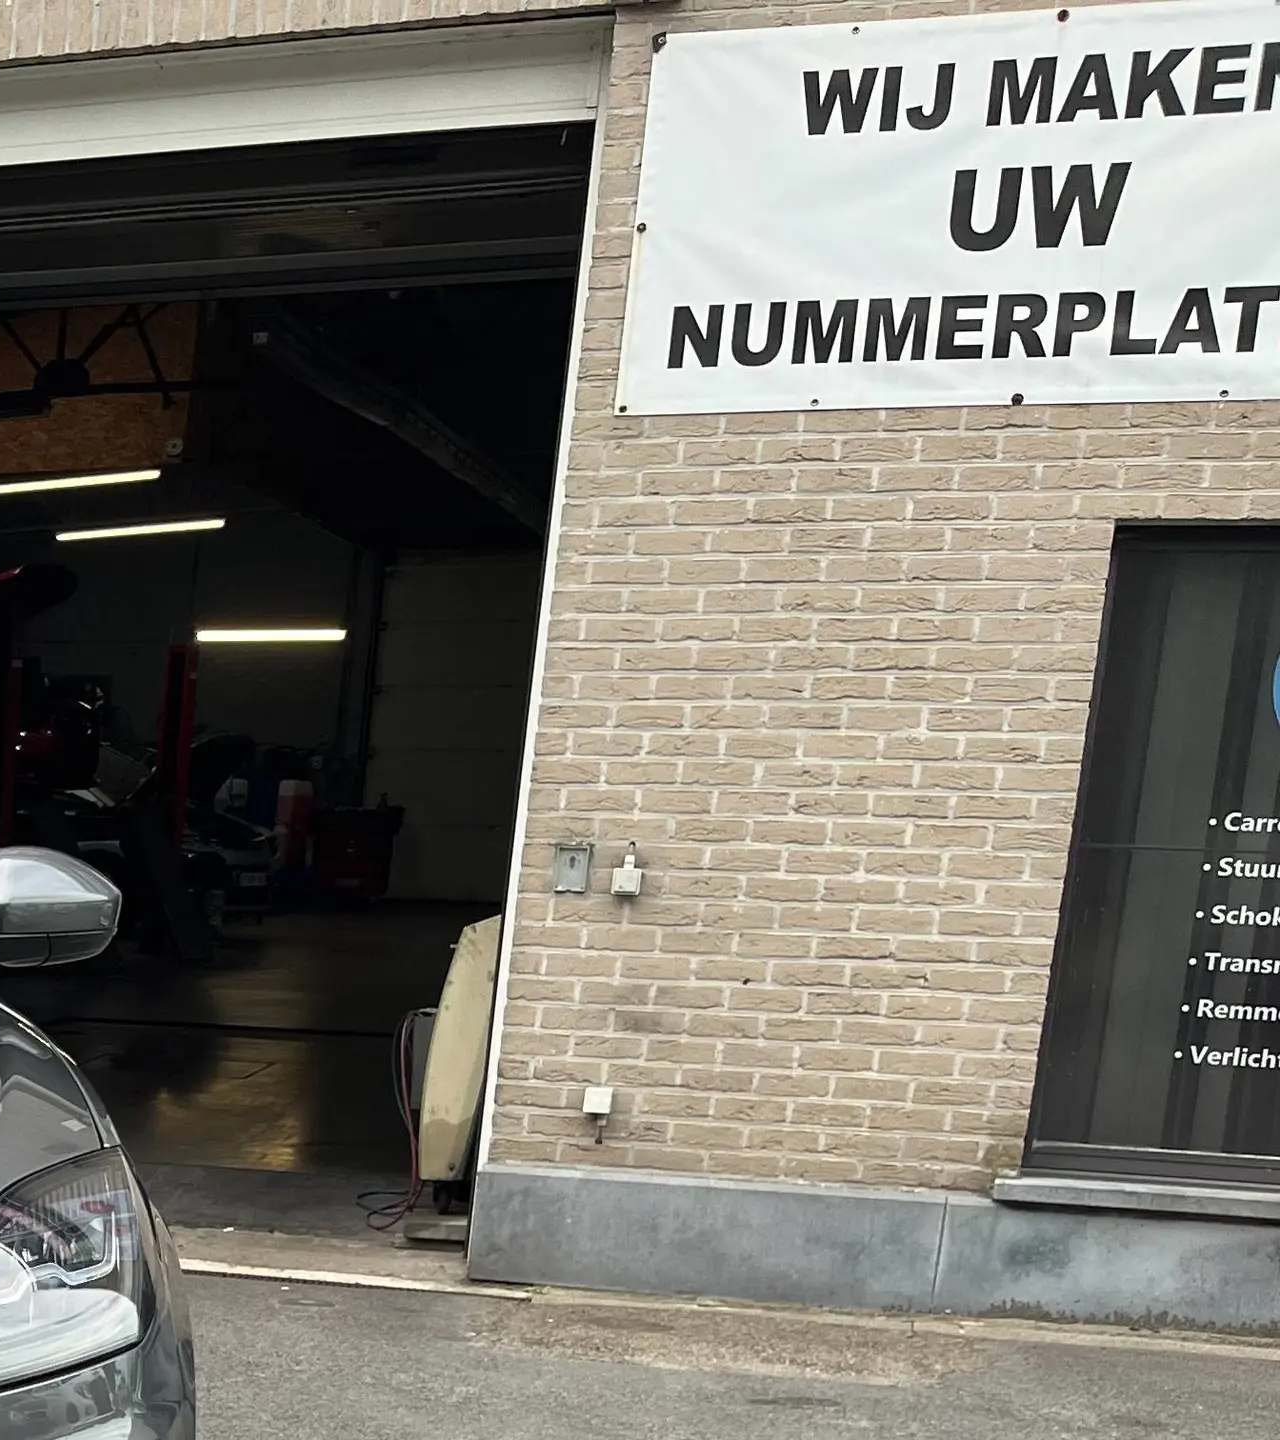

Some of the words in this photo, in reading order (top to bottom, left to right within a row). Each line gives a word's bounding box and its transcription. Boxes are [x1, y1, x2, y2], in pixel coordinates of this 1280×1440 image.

[803, 62, 955, 136] WIJ
[949, 161, 1132, 252] UW
[666, 285, 1280, 369] NUMMERPLAT
[1223, 812, 1280, 832] Carr
[1197, 998, 1280, 1021] Remm
